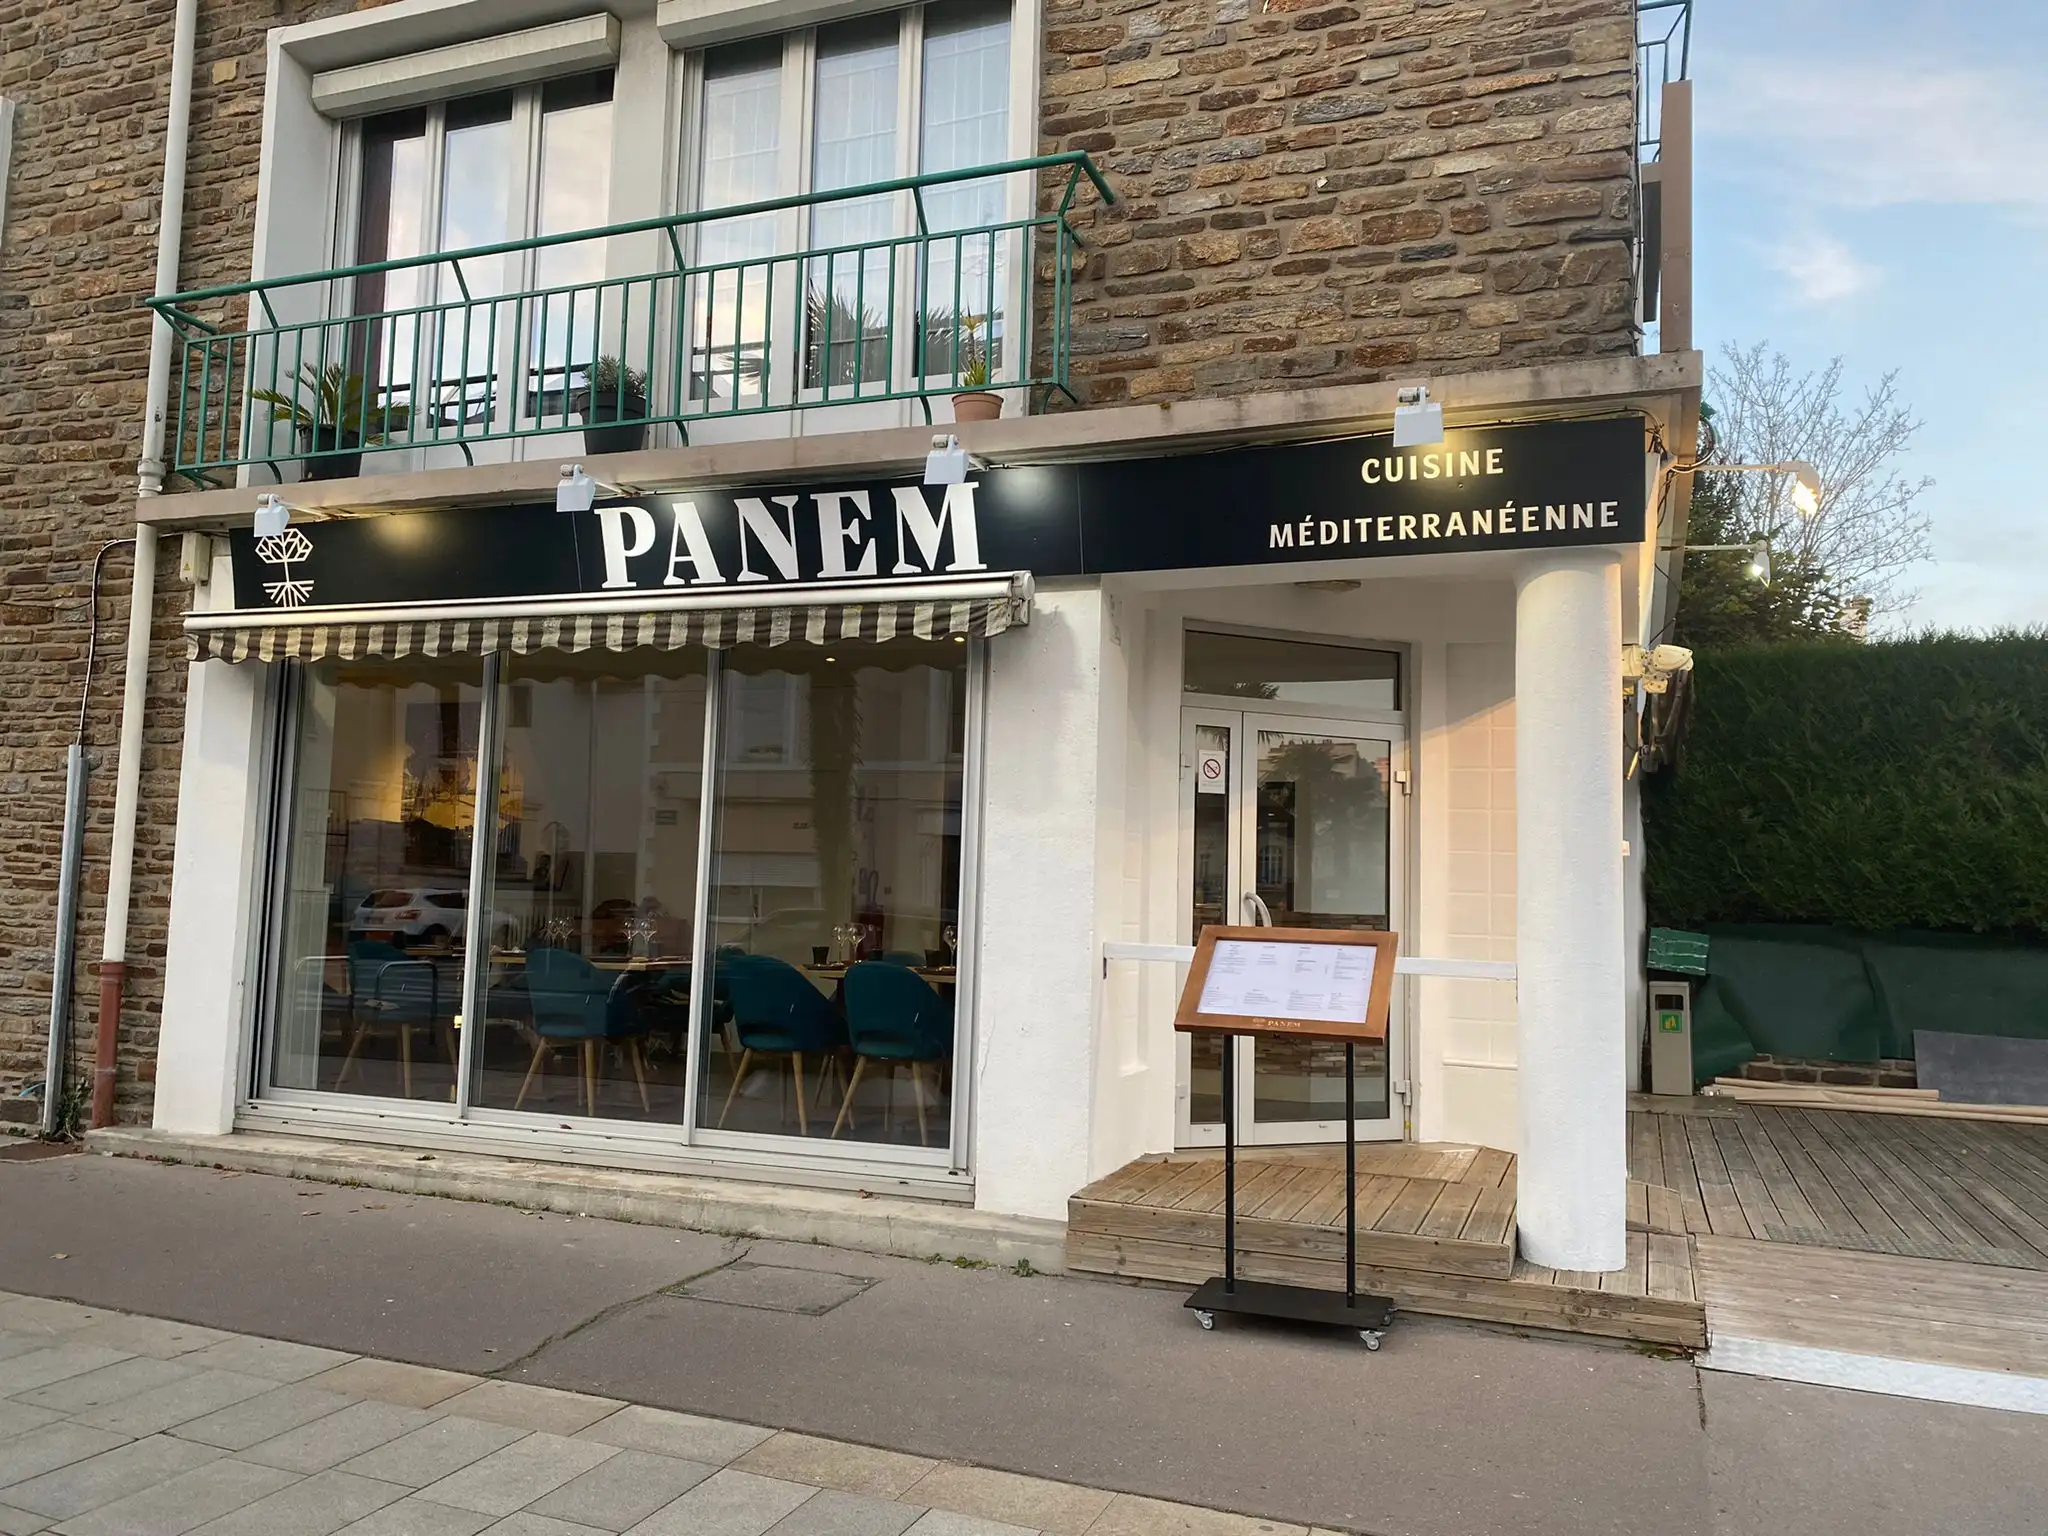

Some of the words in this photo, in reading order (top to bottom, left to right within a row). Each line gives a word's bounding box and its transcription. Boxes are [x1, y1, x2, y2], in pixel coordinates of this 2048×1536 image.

[1361, 448, 1504, 484] CUISINE
[595, 482, 987, 588] PANEM
[1269, 501, 1619, 548] MÉDITERRANÉENNE
